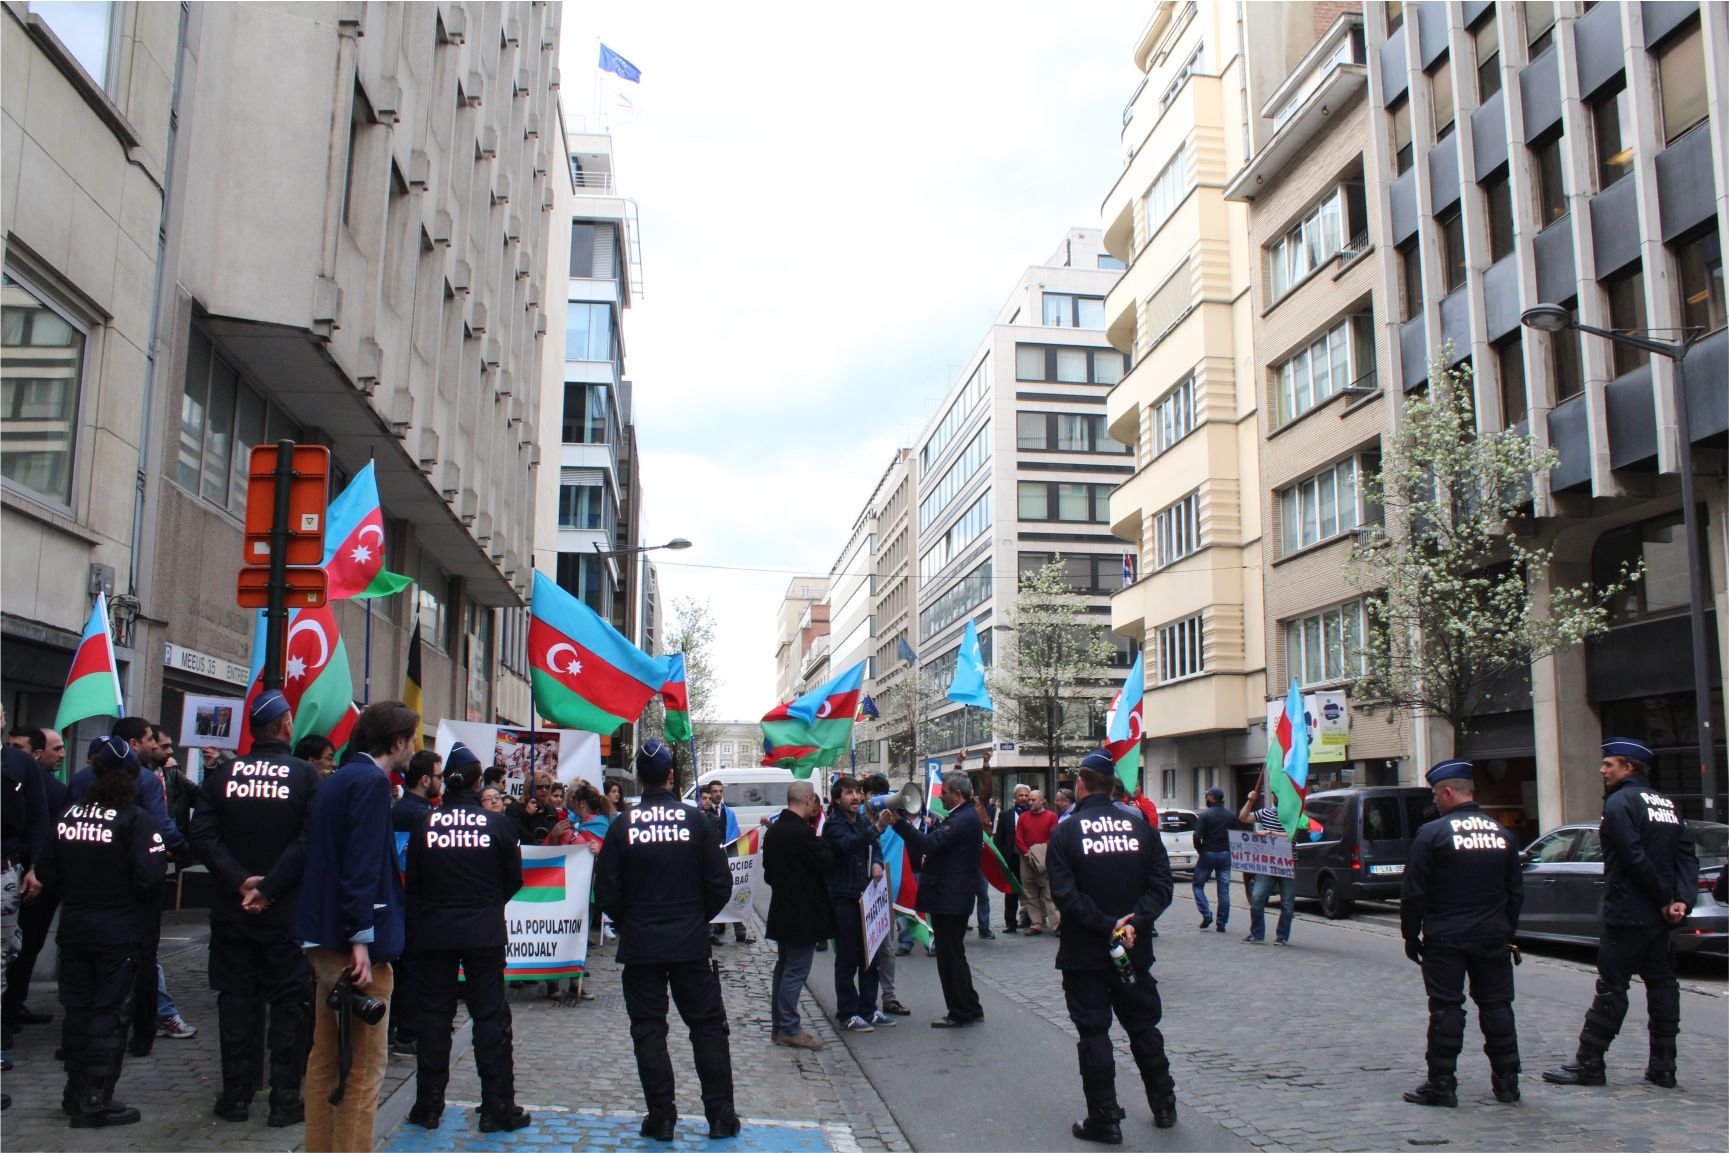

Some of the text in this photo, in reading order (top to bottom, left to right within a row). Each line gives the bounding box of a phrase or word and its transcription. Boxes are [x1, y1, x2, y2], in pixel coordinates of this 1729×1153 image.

[181, 651, 206, 672] MEEUS
[207, 659, 216, 675] 35
[232, 760, 290, 778] Police
[226, 779, 290, 799] Politie
[1640, 792, 1674, 808] Police
[430, 808, 487, 827] Police
[630, 806, 686, 824] Police
[1450, 816, 1499, 832] Police
[57, 821, 113, 843] Politie
[1080, 816, 1133, 834] Police
[427, 829, 491, 848] Politie
[628, 824, 690, 845] Politie
[1241, 832, 1277, 845] OBEY
[1453, 832, 1506, 850] Politie
[1082, 834, 1139, 855] Politie
[1231, 851, 1294, 867] WITHDRAW
[510, 918, 583, 935] LA POPULATION
[506, 941, 557, 958] KHODJALY
